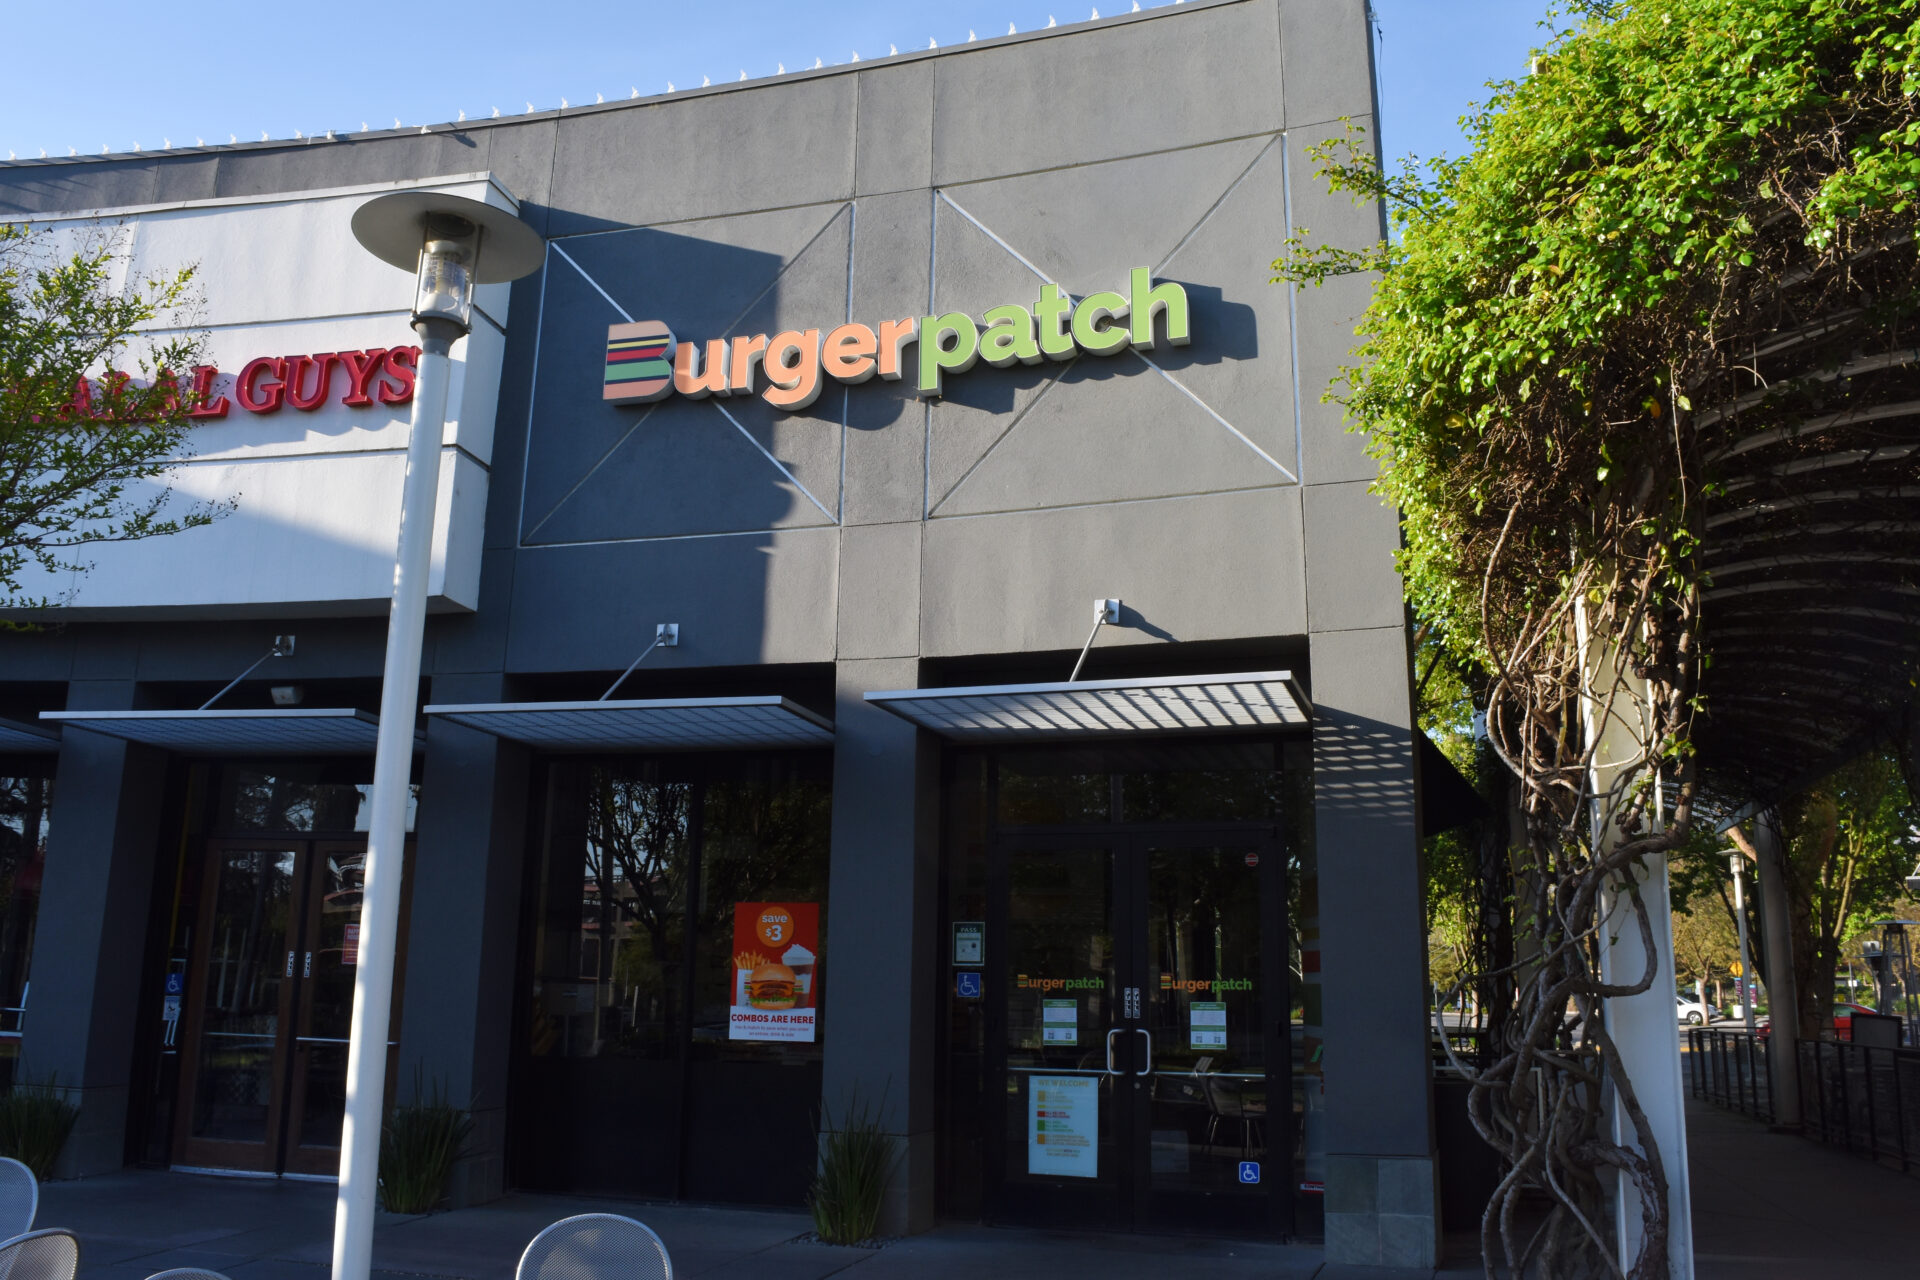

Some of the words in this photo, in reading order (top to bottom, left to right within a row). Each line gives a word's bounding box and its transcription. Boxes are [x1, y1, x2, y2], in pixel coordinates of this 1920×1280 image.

[603, 266, 1191, 411] Burgerpatch
[236, 346, 421, 414] GUYS
[762, 915, 788, 923] save
[765, 924, 783, 941] $3
[731, 1014, 769, 1023] COMBOS
[771, 1015, 788, 1024] ARE
[790, 1015, 814, 1025] HERE
